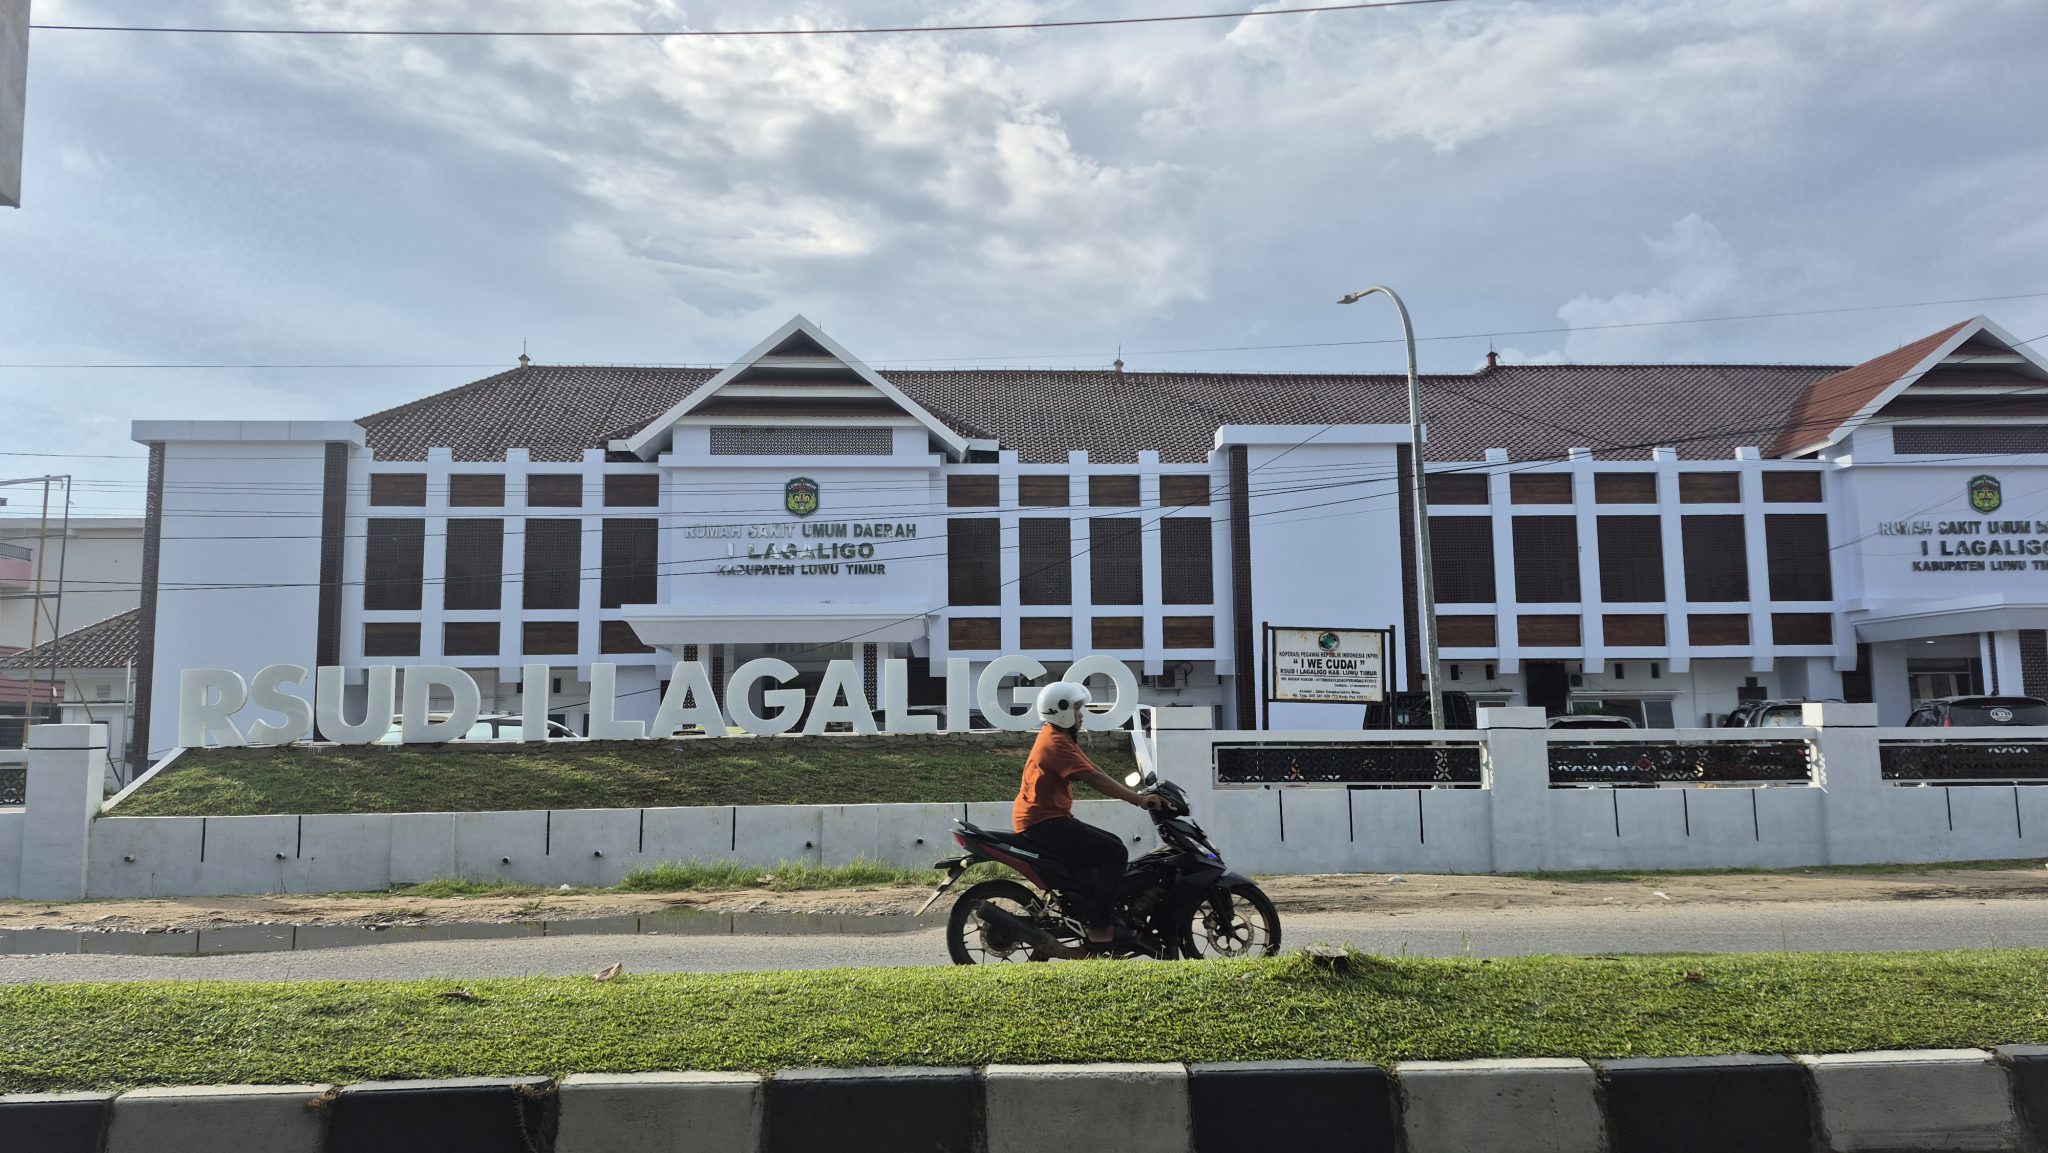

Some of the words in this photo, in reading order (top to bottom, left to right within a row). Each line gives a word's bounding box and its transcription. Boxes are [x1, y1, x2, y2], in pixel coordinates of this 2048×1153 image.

[684, 524, 741, 538] RUMAH
[748, 524, 796, 538] SAKIT
[802, 523, 847, 537] UMUM
[853, 523, 916, 538] DAERAH
[1880, 521, 1933, 535] RUMAH
[1938, 521, 1982, 534] SAKIT
[1987, 521, 2031, 534] UMUM
[727, 543, 734, 557] I
[748, 542, 875, 559] LAGALIGO
[1921, 540, 1929, 556] I
[716, 564, 795, 576] KABUPATEN
[801, 564, 839, 575] LUWU
[846, 564, 886, 575] TIMUR
[1912, 560, 1985, 571] KABUPATEN
[1990, 560, 2027, 571] LUWU
[1307, 658, 1323, 669] WE
[1326, 659, 1357, 670] CUDAI
[180, 663, 482, 747] RSUD
[522, 663, 550, 742] I
[588, 654, 1139, 741] LAGALIGO
